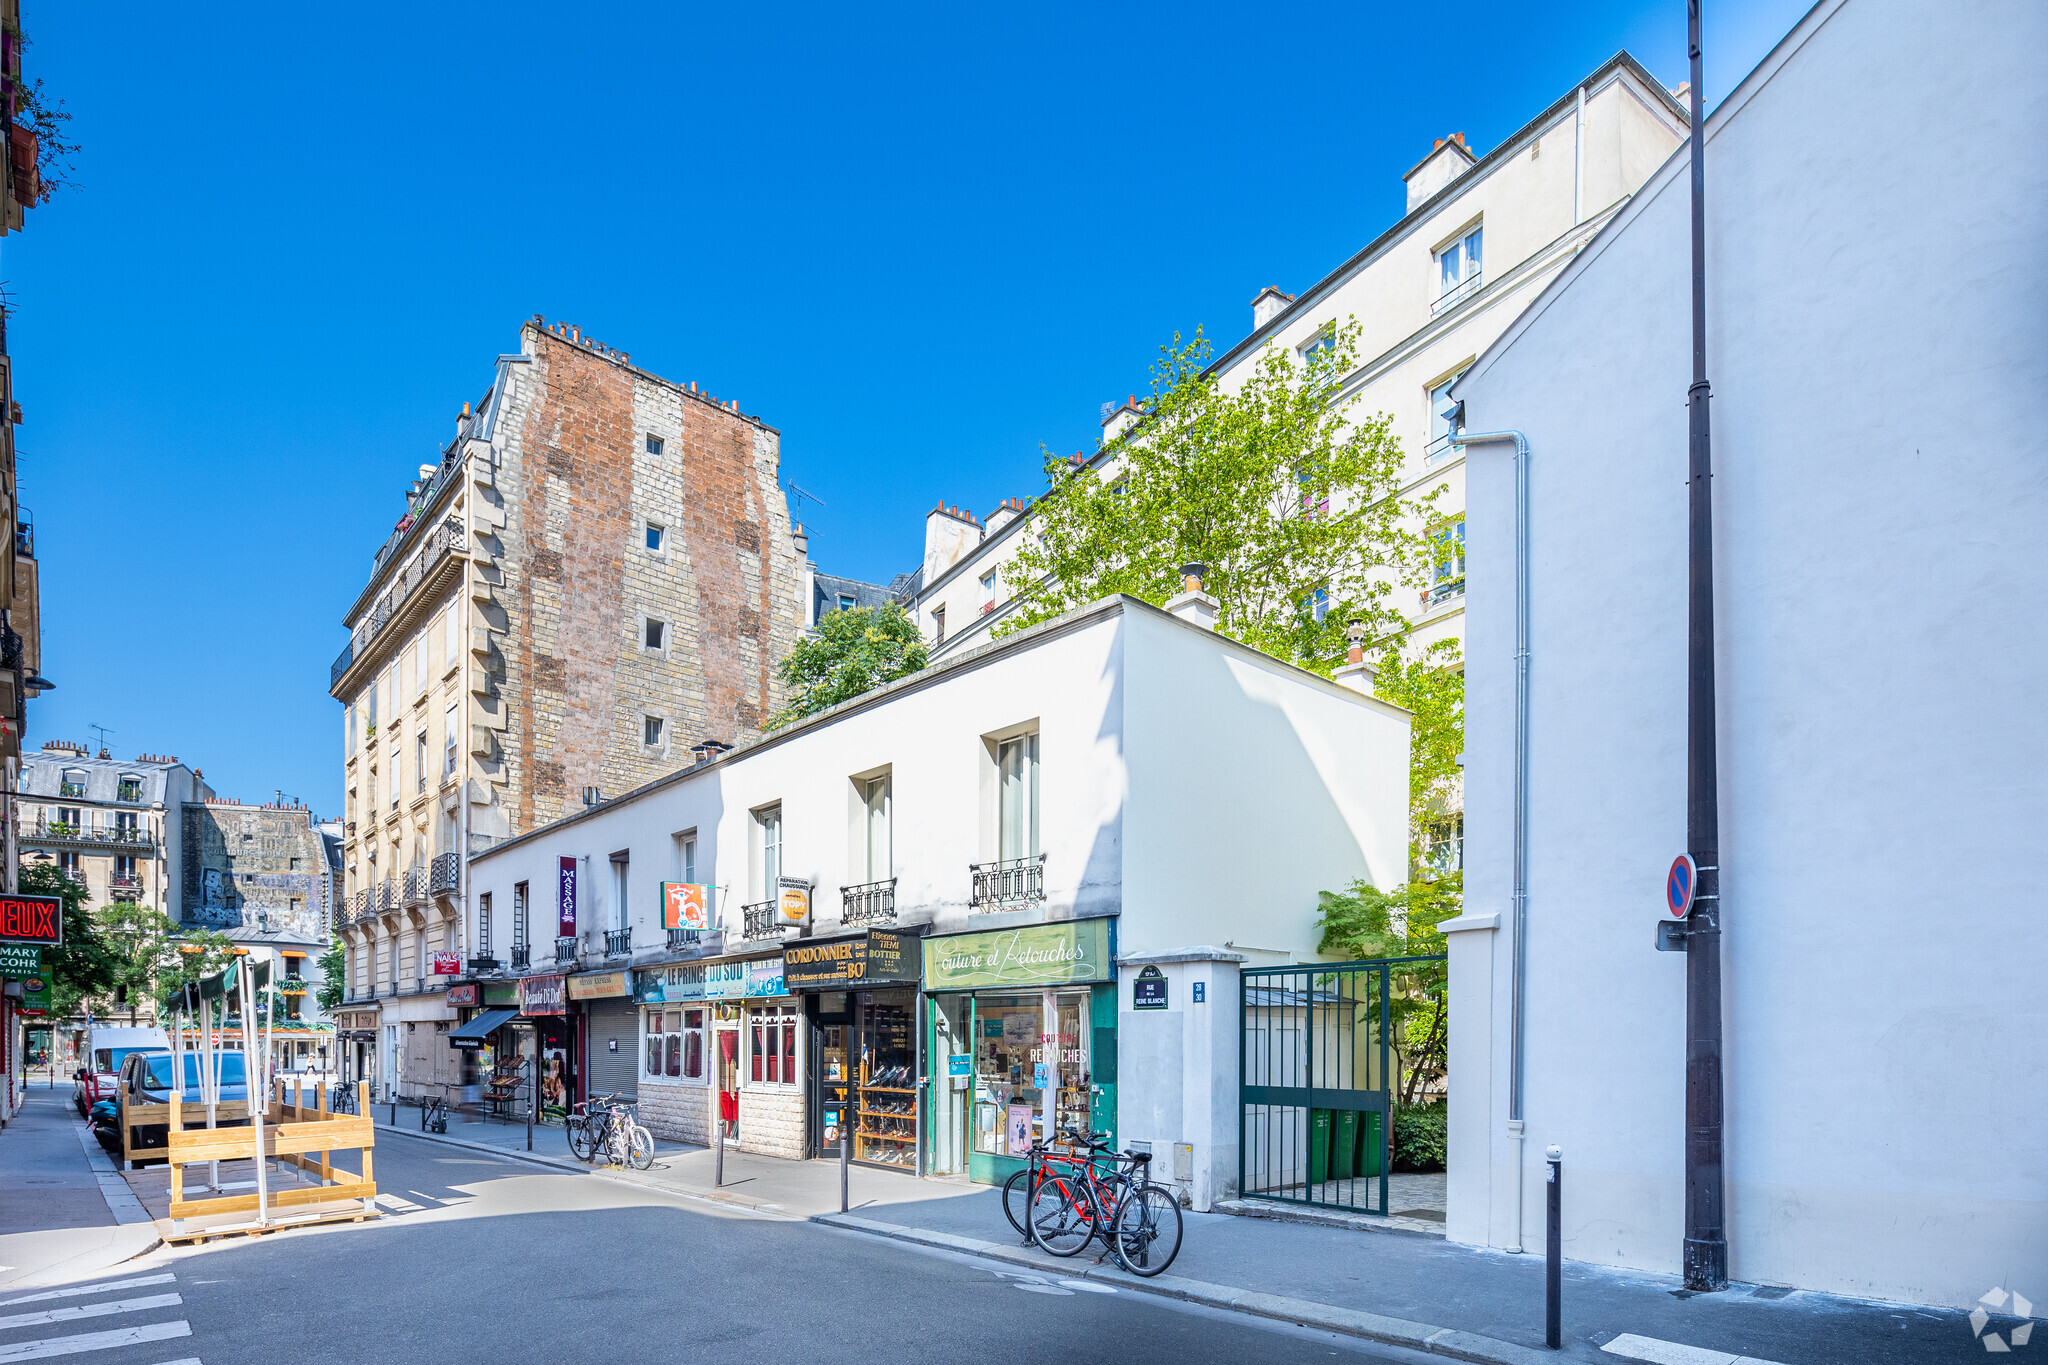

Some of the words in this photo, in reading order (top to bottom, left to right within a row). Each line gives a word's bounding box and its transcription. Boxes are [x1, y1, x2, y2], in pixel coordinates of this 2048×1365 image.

[561, 869, 575, 915] MASSAGE
[783, 900, 806, 909] TOPY
[0, 901, 55, 937] EUX
[0, 947, 39, 958] MARY
[437, 951, 458, 963] NAILS
[785, 943, 853, 965] CORDONNIER
[869, 949, 901, 960] BOTTIER
[987, 949, 1001, 967] et
[994, 931, 1084, 981] Retouches
[0, 958, 38, 968] COHR
[667, 967, 676, 986] LE
[677, 965, 707, 985] PRINCE
[710, 963, 721, 982] DU
[724, 961, 743, 981] SUD
[525, 988, 543, 1005] Beauté
[1041, 1033, 1077, 1043] COUTURE
[1030, 1048, 1087, 1063] REUCHES
